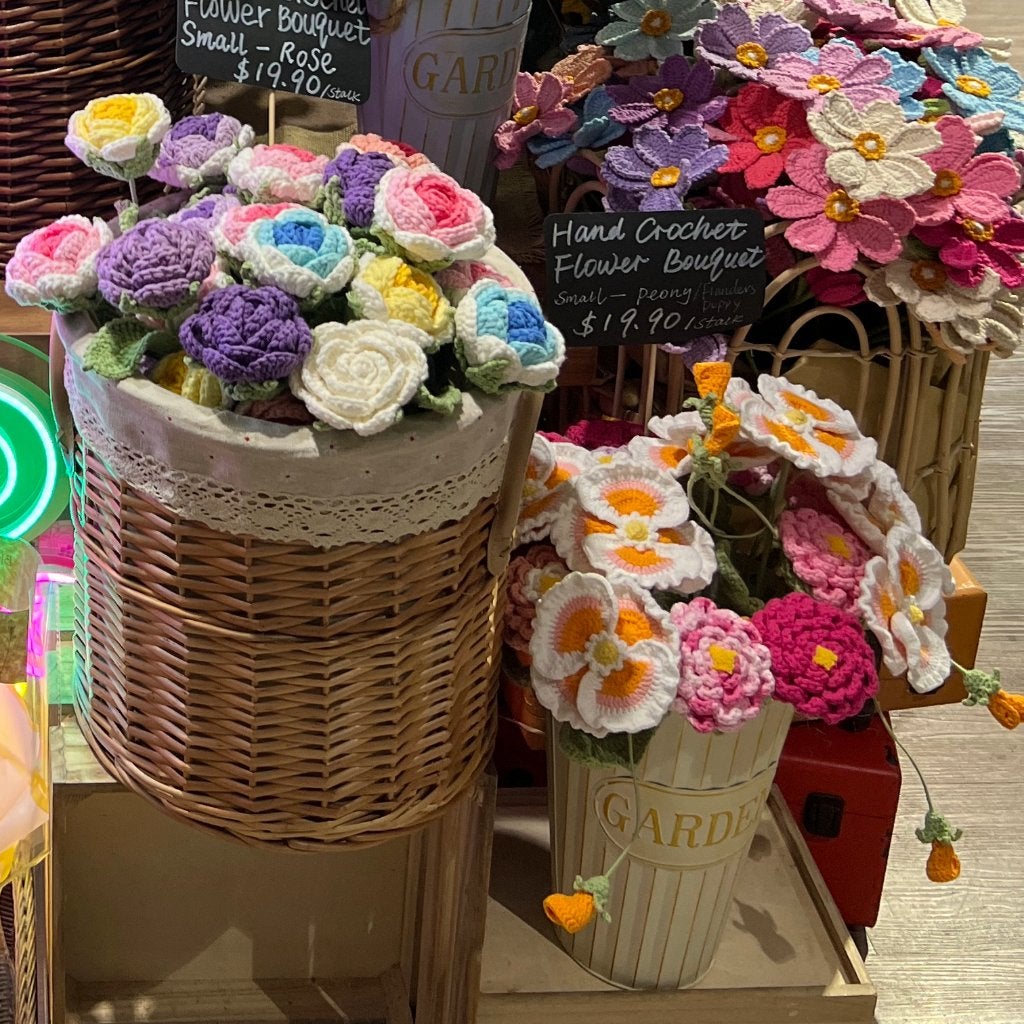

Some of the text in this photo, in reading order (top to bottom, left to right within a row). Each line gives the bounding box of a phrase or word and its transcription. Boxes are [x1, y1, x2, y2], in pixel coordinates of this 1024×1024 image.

[181, 20, 336, 74] Small Rose
[278, 5, 371, 49] Bouquet
[413, 47, 517, 94] GARD
[553, 216, 748, 247] Hand Crochet
[554, 246, 765, 284] Flower Bouquet
[554, 288, 607, 305] Small
